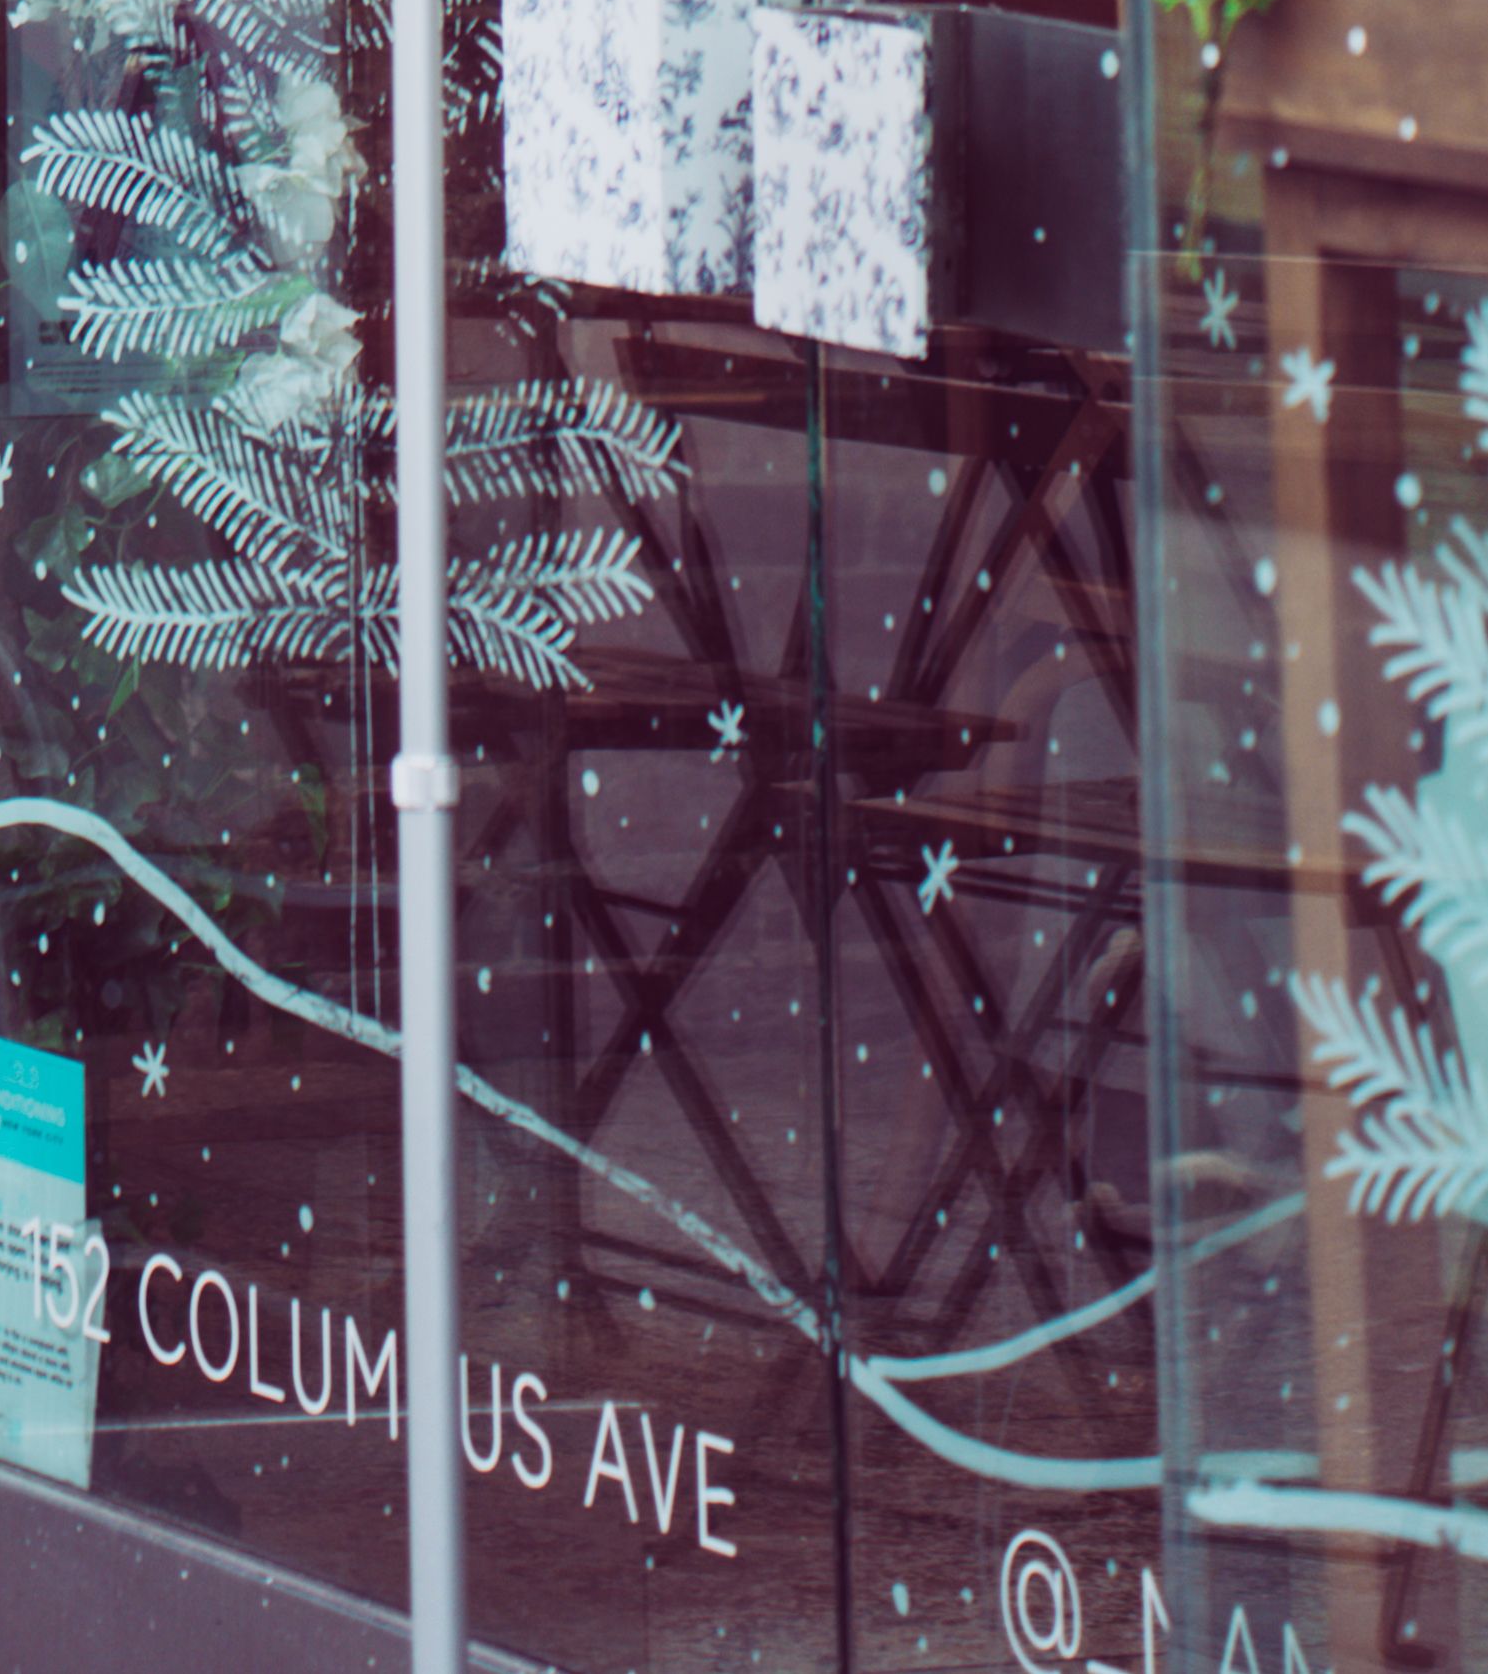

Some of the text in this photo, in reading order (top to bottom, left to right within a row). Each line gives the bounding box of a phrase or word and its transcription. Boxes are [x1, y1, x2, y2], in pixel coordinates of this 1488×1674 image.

[21, 1215, 112, 1344] 152
[138, 1252, 553, 1490] COLUMUS
[583, 1400, 738, 1558] AVE
